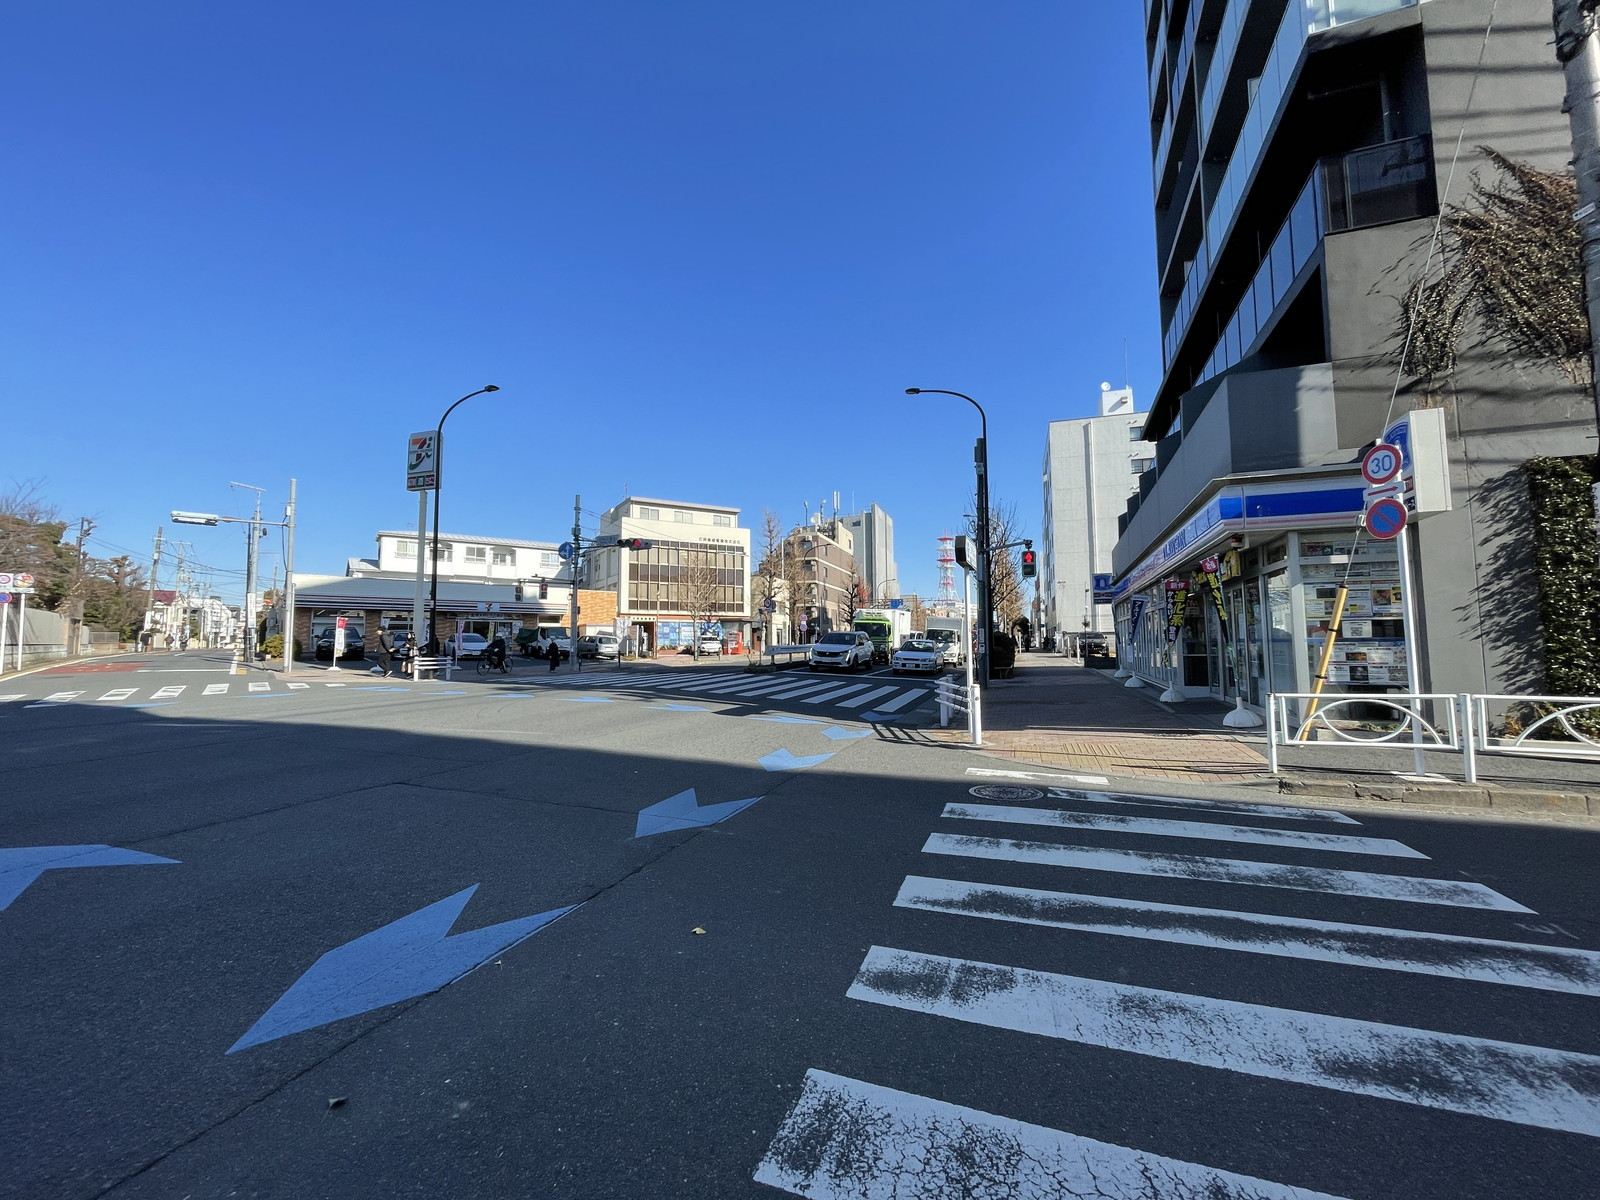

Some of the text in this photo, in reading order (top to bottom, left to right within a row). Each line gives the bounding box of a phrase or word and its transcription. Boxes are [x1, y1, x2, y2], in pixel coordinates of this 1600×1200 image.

[1371, 455, 1393, 475] 30
[1171, 590, 1187, 626] 進化系
